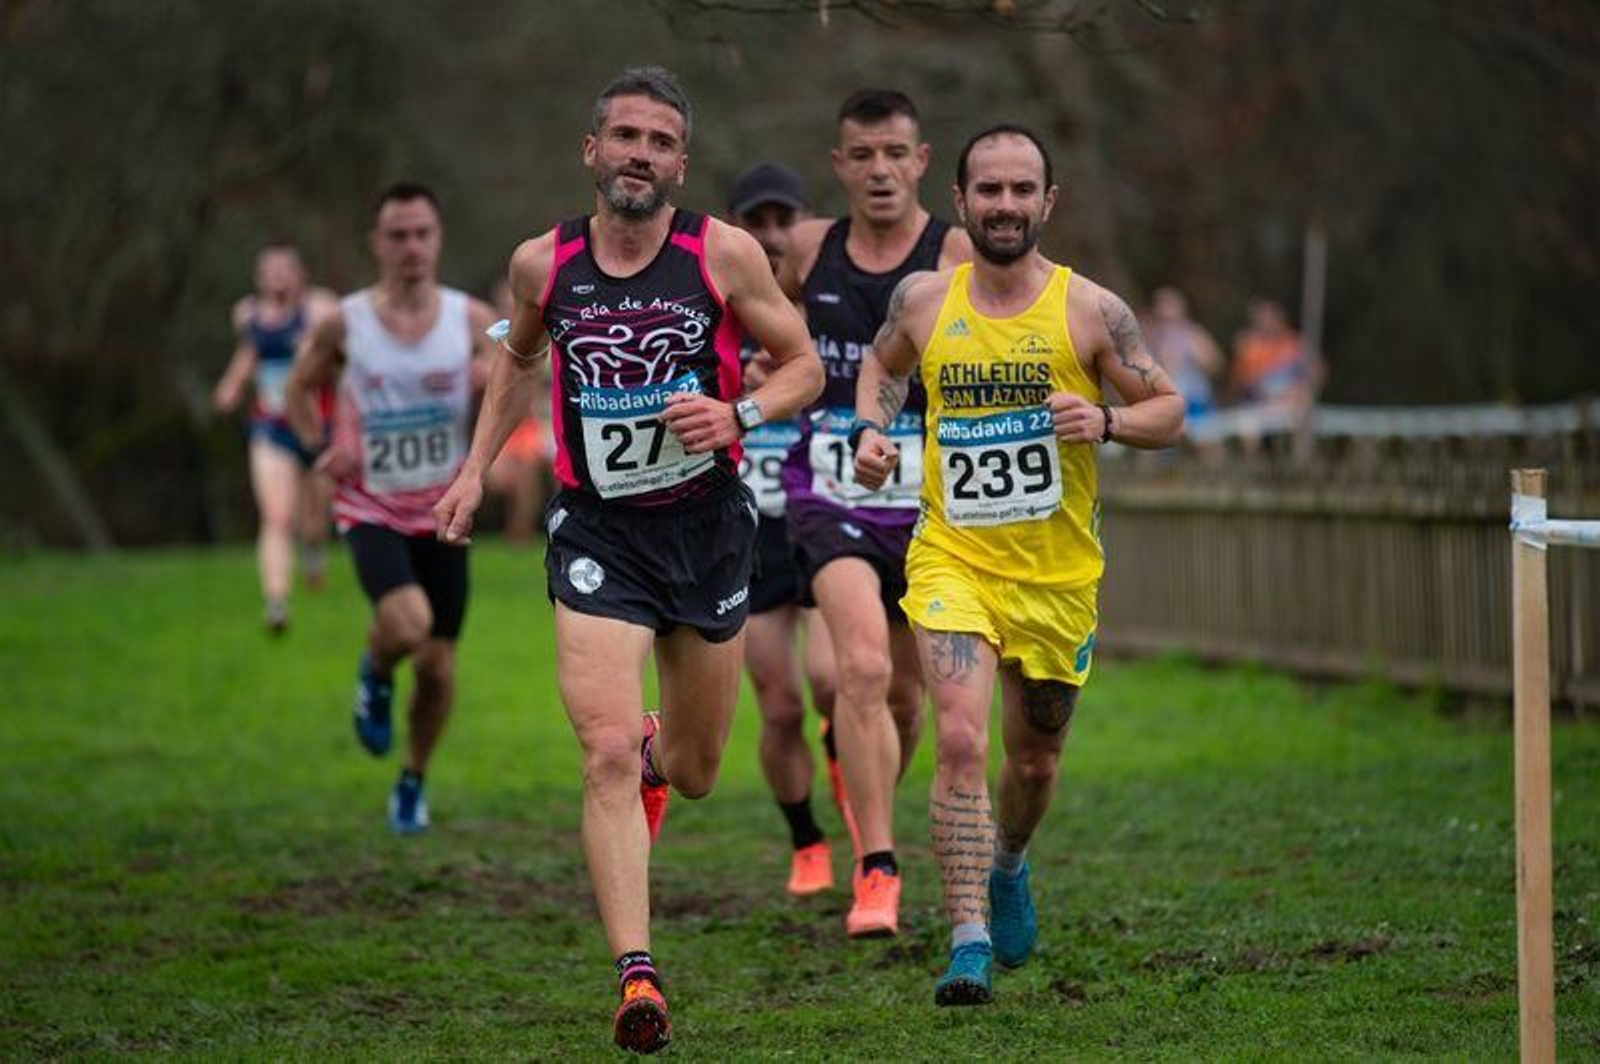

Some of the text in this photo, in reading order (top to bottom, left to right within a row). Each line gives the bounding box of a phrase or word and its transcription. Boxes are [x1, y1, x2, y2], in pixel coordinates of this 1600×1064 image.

[580, 302, 610, 320] Ría
[618, 296, 643, 311] de
[812, 334, 841, 360] ÍA
[939, 362, 1051, 384] ATHLETICS
[580, 388, 674, 411] Ribadavia
[942, 387, 975, 410] SAN
[937, 410, 1053, 440] Ribadavia 22
[369, 430, 449, 474] 208
[829, 441, 902, 483] 11
[950, 443, 1053, 499] 239
